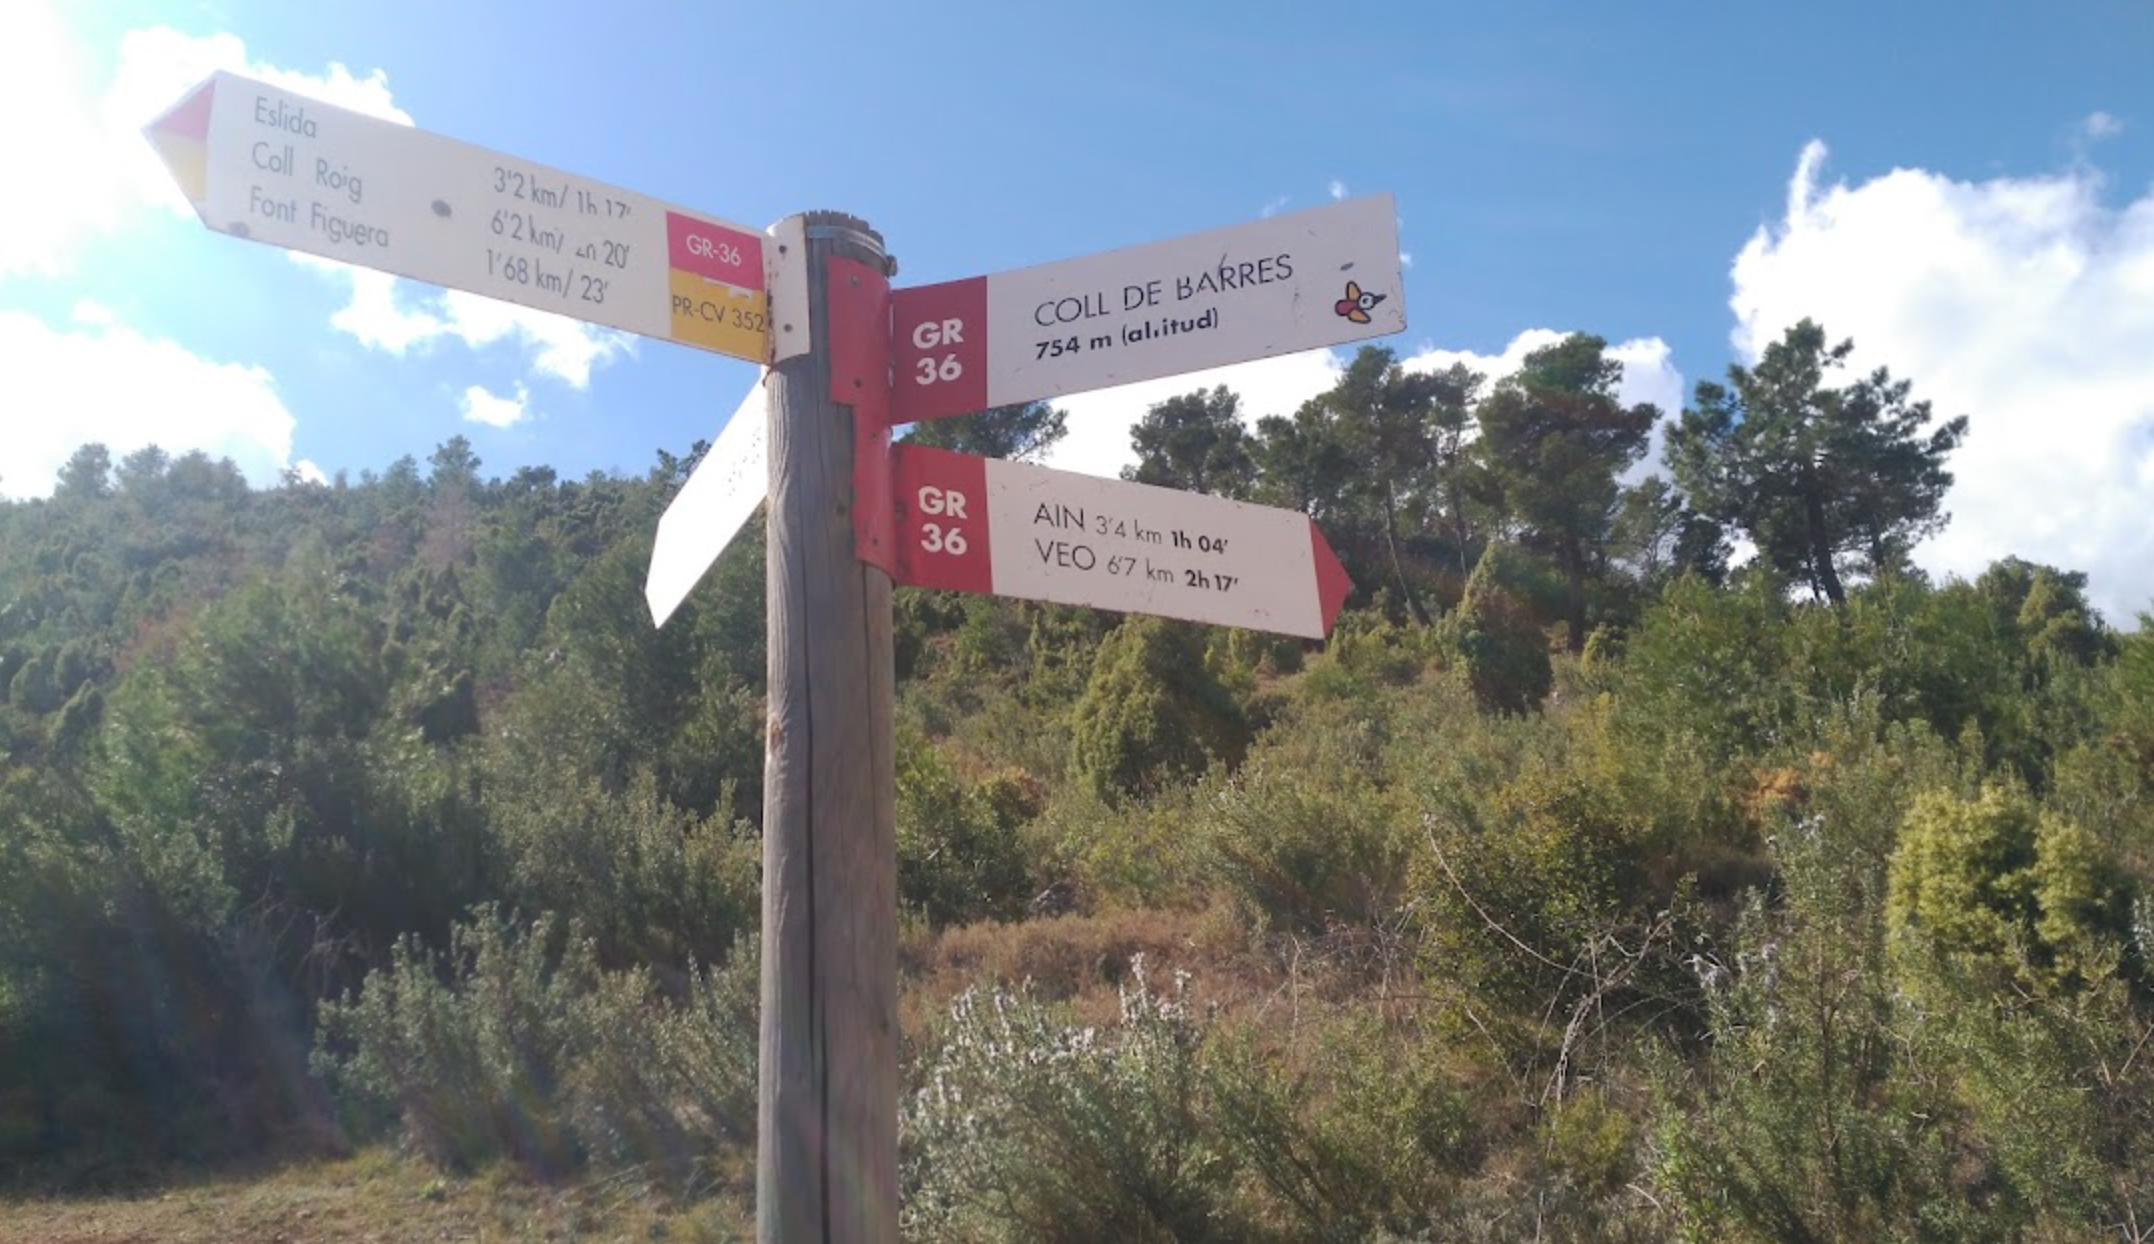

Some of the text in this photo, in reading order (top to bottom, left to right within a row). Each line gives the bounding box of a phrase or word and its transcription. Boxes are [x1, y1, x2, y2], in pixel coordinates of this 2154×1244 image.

[255, 96, 316, 138] Eslida
[252, 141, 295, 177] Coll
[316, 157, 362, 204] Roig
[250, 186, 297, 222] Font
[311, 203, 389, 247] Figuera
[686, 234, 741, 266] GR-36
[1035, 253, 1294, 327] COLL DE BARRES
[672, 295, 765, 333] PR-CV 352
[912, 317, 965, 349] GR
[1034, 334, 1081, 361] 754
[1089, 330, 1112, 350] m
[915, 352, 963, 386] 36
[918, 485, 968, 519] GR
[921, 522, 968, 556] 36
[1033, 501, 1086, 532] AIN
[1135, 519, 1163, 544] km
[1172, 530, 1192, 550] 1h
[1035, 538, 1096, 571] VEO
[1147, 560, 1175, 584] km
[1184, 568, 1211, 589] 2h
